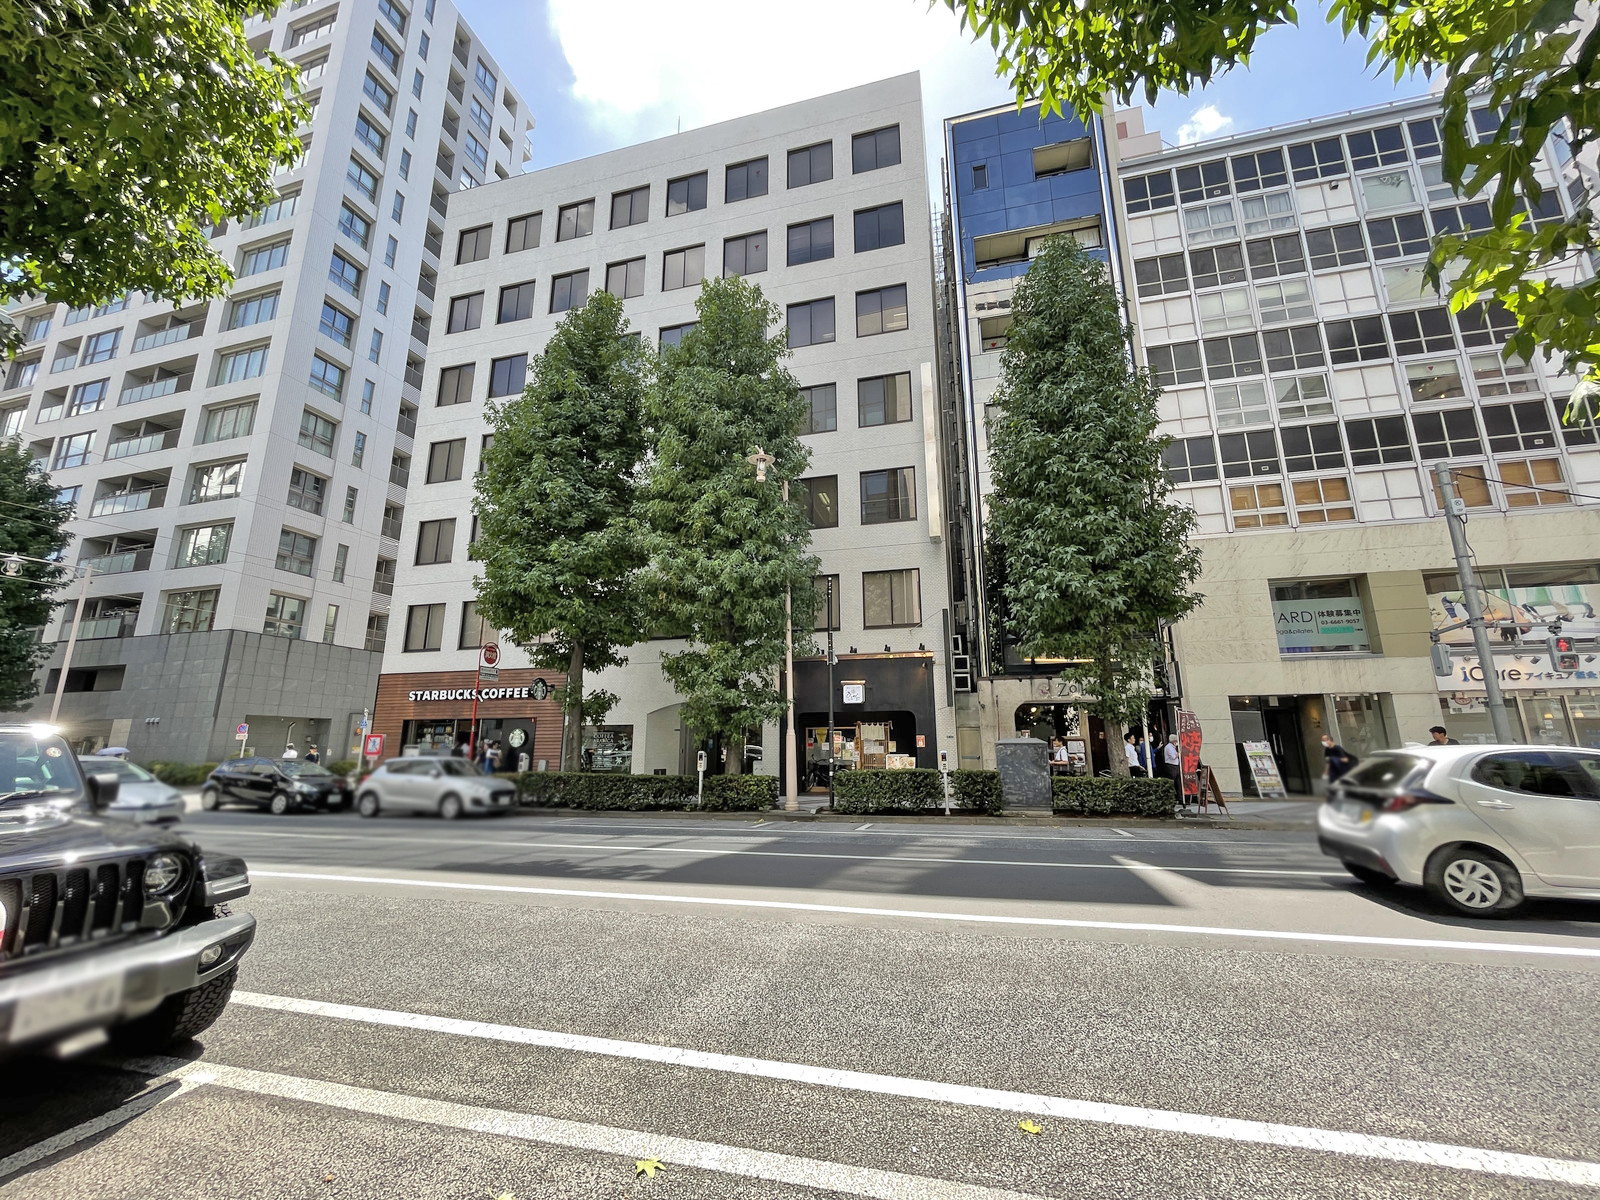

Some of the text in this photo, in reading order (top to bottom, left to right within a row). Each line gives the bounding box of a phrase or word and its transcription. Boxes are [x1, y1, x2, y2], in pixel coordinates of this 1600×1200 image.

[1318, 609, 1361, 618] 体験募集中
[408, 687, 530, 701] STARBUCKS COFFEE
